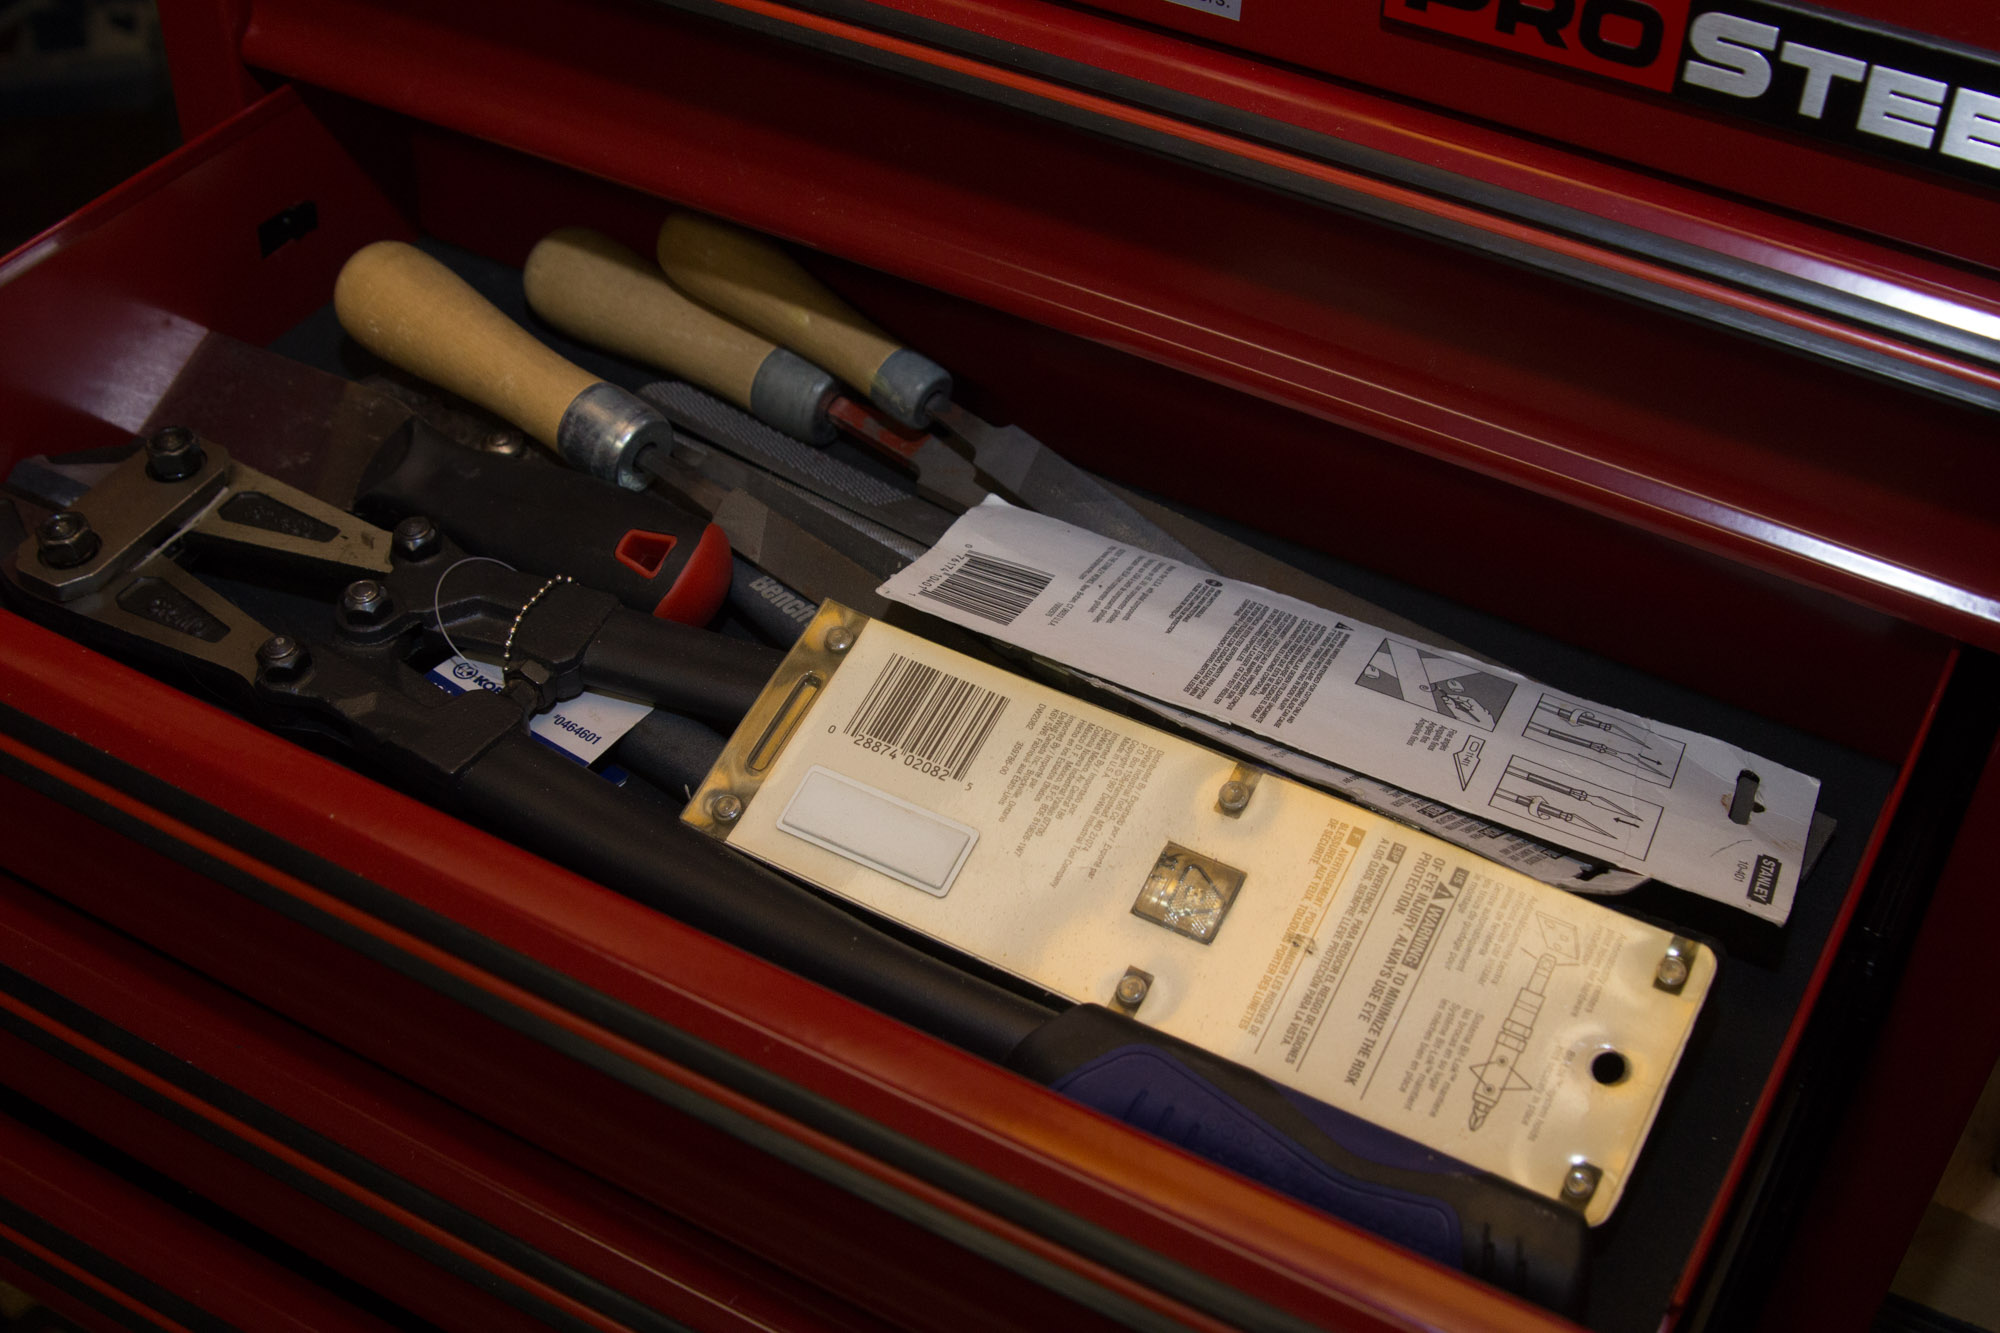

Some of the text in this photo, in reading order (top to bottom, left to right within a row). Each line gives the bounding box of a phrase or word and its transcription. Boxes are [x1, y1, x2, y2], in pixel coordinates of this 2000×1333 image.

[1395, 0, 1665, 68] RO
[940, 554, 965, 573] 76174
[1050, 711, 1067, 733] DeWalt
[1419, 721, 1436, 743] Angles fins
[998, 702, 1046, 775] DW2082 359786-00
[1037, 732, 1054, 755] Canada
[1085, 725, 1103, 748] Colonia
[1094, 728, 1111, 752] DeWalt
[1116, 735, 1130, 754] Made
[1405, 735, 1417, 746] finos
[1427, 740, 1438, 751] finos
[1438, 729, 1456, 751] Fine angles
[827, 725, 974, 791] 0 28874 02082 5
[1033, 718, 1086, 803] Hecho en los Estados Unidos
[1074, 747, 1090, 767] Nueva
[1128, 756, 1139, 769] Box
[1139, 746, 1155, 768] DeWalt
[1141, 749, 1163, 782] Distributed
[1460, 751, 1473, 766] 11-411
[1057, 767, 1078, 797] Industrial
[1122, 768, 1143, 797] Industrial
[1062, 785, 1079, 807] Central
[1114, 797, 1126, 811] Tool
[997, 799, 1015, 823] Ontario
[1049, 738, 1138, 888] Copyright 1997 DeWalt Industrial Tool Company
[1093, 819, 1103, 831] MD
[1325, 817, 1338, 829] DE
[1321, 822, 1348, 864] BLESSURES
[1372, 844, 1386, 860] LOS
[1379, 837, 1389, 845] A
[1312, 864, 1327, 881] AUX
[1312, 847, 1347, 906] AVERTISSEMENT
[1360, 859, 1378, 883] OJOS,
[1734, 860, 1749, 883] 10-401
[1753, 858, 1776, 902] STANLEY
[1356, 863, 1389, 917] ADVERTENCIA:
[1391, 851, 1432, 918] PROTECTION.
[1344, 882, 1367, 917] SIEMPRE
[1299, 910, 1316, 933] POUR
[1332, 916, 1350, 941] LLEVE
[1345, 917, 1362, 940] PARA
[1357, 856, 1445, 1023] OF EYE INJURY, ALWAYS USE EYE
[1403, 904, 1441, 968] WARNING:
[1266, 944, 1287, 974] PORTER
[1328, 939, 1351, 974] REDUCIR
[1257, 974, 1272, 991] DES
[1270, 974, 1284, 991] LES
[1323, 974, 1335, 985] EL
[1391, 970, 1407, 987] TO
[1238, 991, 1263, 1030] LUNETTES
[1253, 990, 1276, 1024] RISQUES
[1297, 988, 1315, 1010] PARA
[1309, 985, 1329, 1014] RIESGO
[1292, 1010, 1304, 1021] LA
[1303, 1014, 1315, 1026] DE
[1367, 985, 1400, 1037] MINIMIZE
[1247, 1024, 1260, 1036] DE
[1279, 1021, 1298, 1047] VISTA.
[1284, 1025, 1309, 1064] LESIONES
[1356, 1036, 1376, 1060] THE
[1343, 1059, 1365, 1086] RISK
